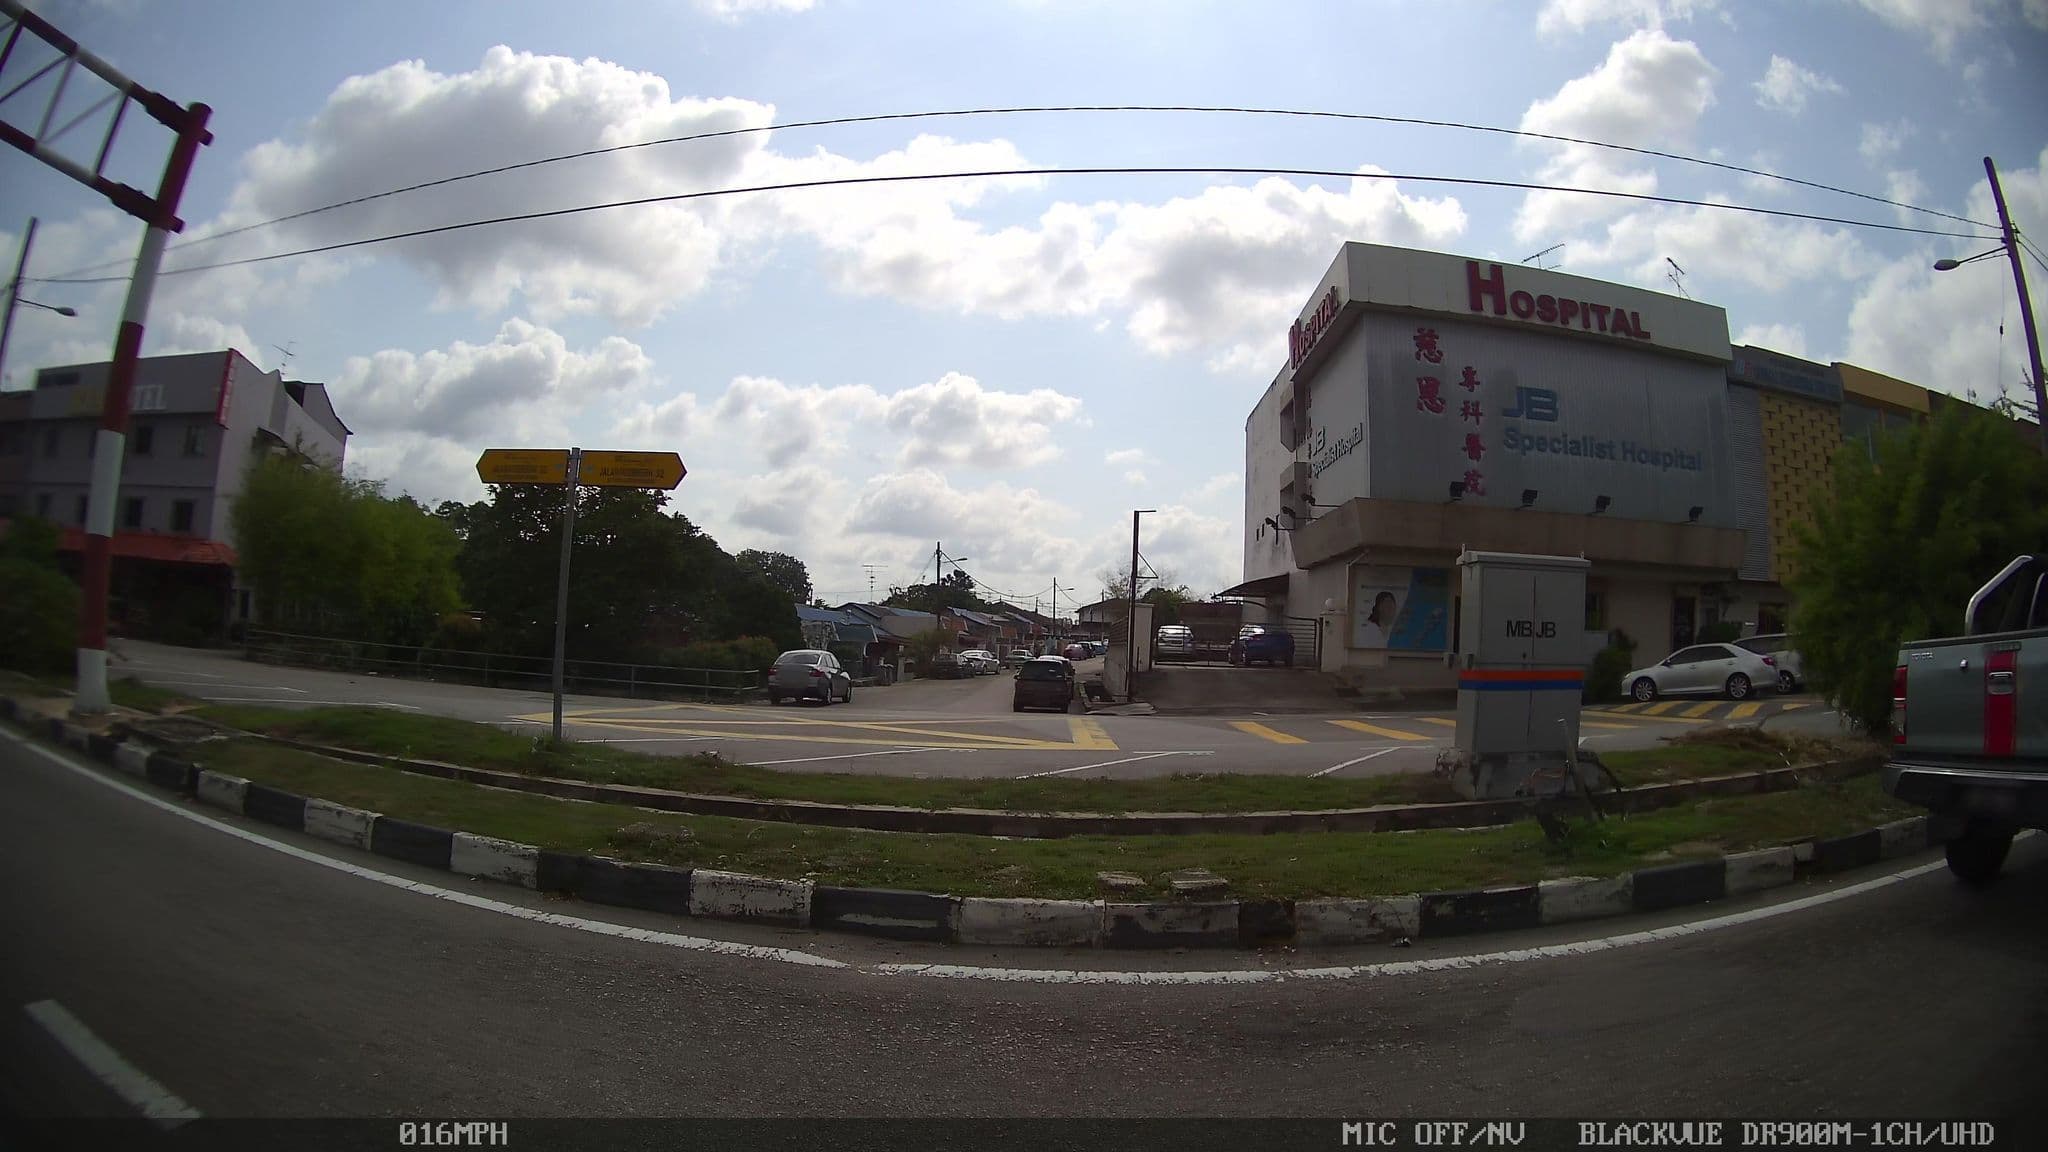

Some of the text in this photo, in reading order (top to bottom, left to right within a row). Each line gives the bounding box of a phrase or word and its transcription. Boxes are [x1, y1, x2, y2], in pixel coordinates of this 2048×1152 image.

[1466, 260, 1651, 339] HOSPITAL
[1289, 285, 1339, 370] HOSPITAL
[1502, 386, 1559, 423] JB
[1336, 423, 1363, 457] Hospital
[1503, 426, 1705, 473] Specialist Hospital
